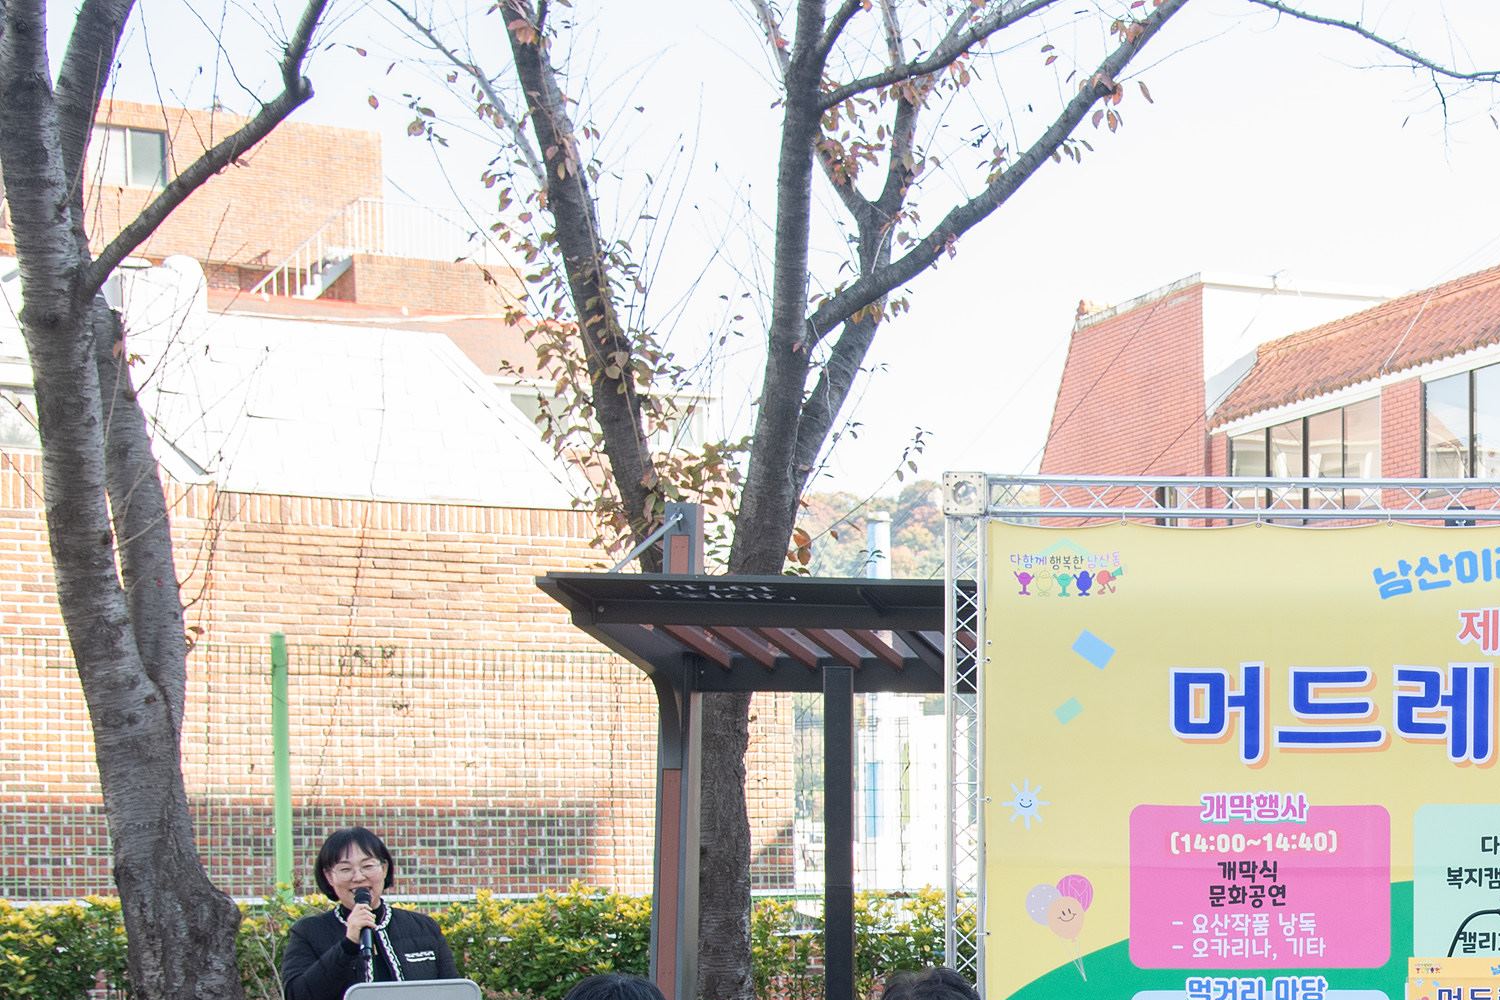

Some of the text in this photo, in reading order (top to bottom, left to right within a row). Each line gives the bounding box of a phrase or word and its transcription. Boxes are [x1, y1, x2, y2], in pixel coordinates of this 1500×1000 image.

[1010, 553, 1047, 569] 다함께
[1049, 554, 1084, 571] 행복한
[1171, 662, 1494, 764] 머드레
[1201, 793, 1308, 822] 개막행사
[1217, 860, 1278, 883] 개막식
[1208, 884, 1287, 908] 문화공연
[1192, 913, 1270, 937] 요산작품
[1279, 912, 1317, 937] 낭독
[1192, 938, 1277, 960] 오카리나,
[1286, 937, 1326, 958] 기타
